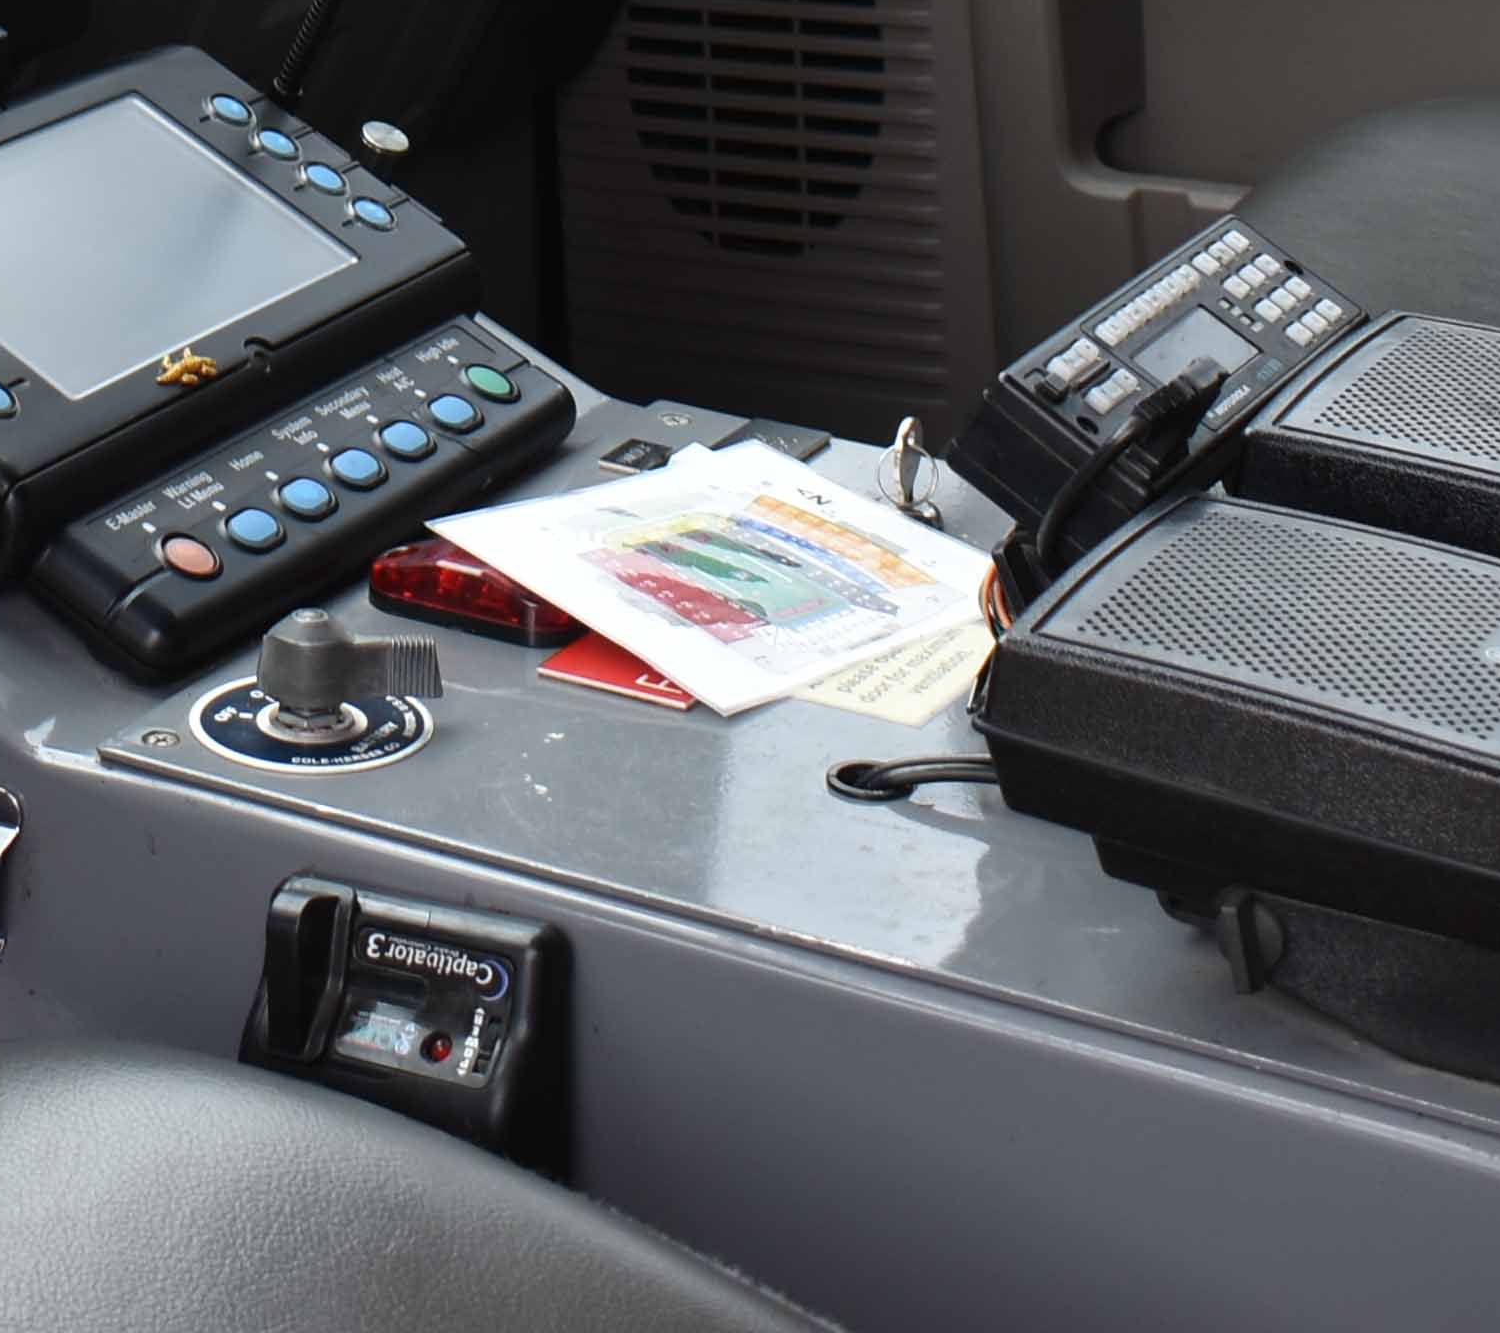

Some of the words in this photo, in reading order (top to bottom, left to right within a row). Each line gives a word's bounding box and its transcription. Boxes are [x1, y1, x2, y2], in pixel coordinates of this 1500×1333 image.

[415, 346, 442, 363] High
[437, 337, 460, 352] Idle
[314, 386, 370, 417] Secondary
[339, 400, 372, 420] Menu
[271, 416, 313, 441] System
[293, 430, 318, 446] Info
[228, 450, 264, 472] Home
[162, 470, 214, 500] Warning
[189, 482, 225, 502] Menu
[105, 500, 157, 531] E-Master
[213, 705, 238, 723] OFF
[366, 933, 386, 958] 3
[385, 943, 493, 985] Captivator
